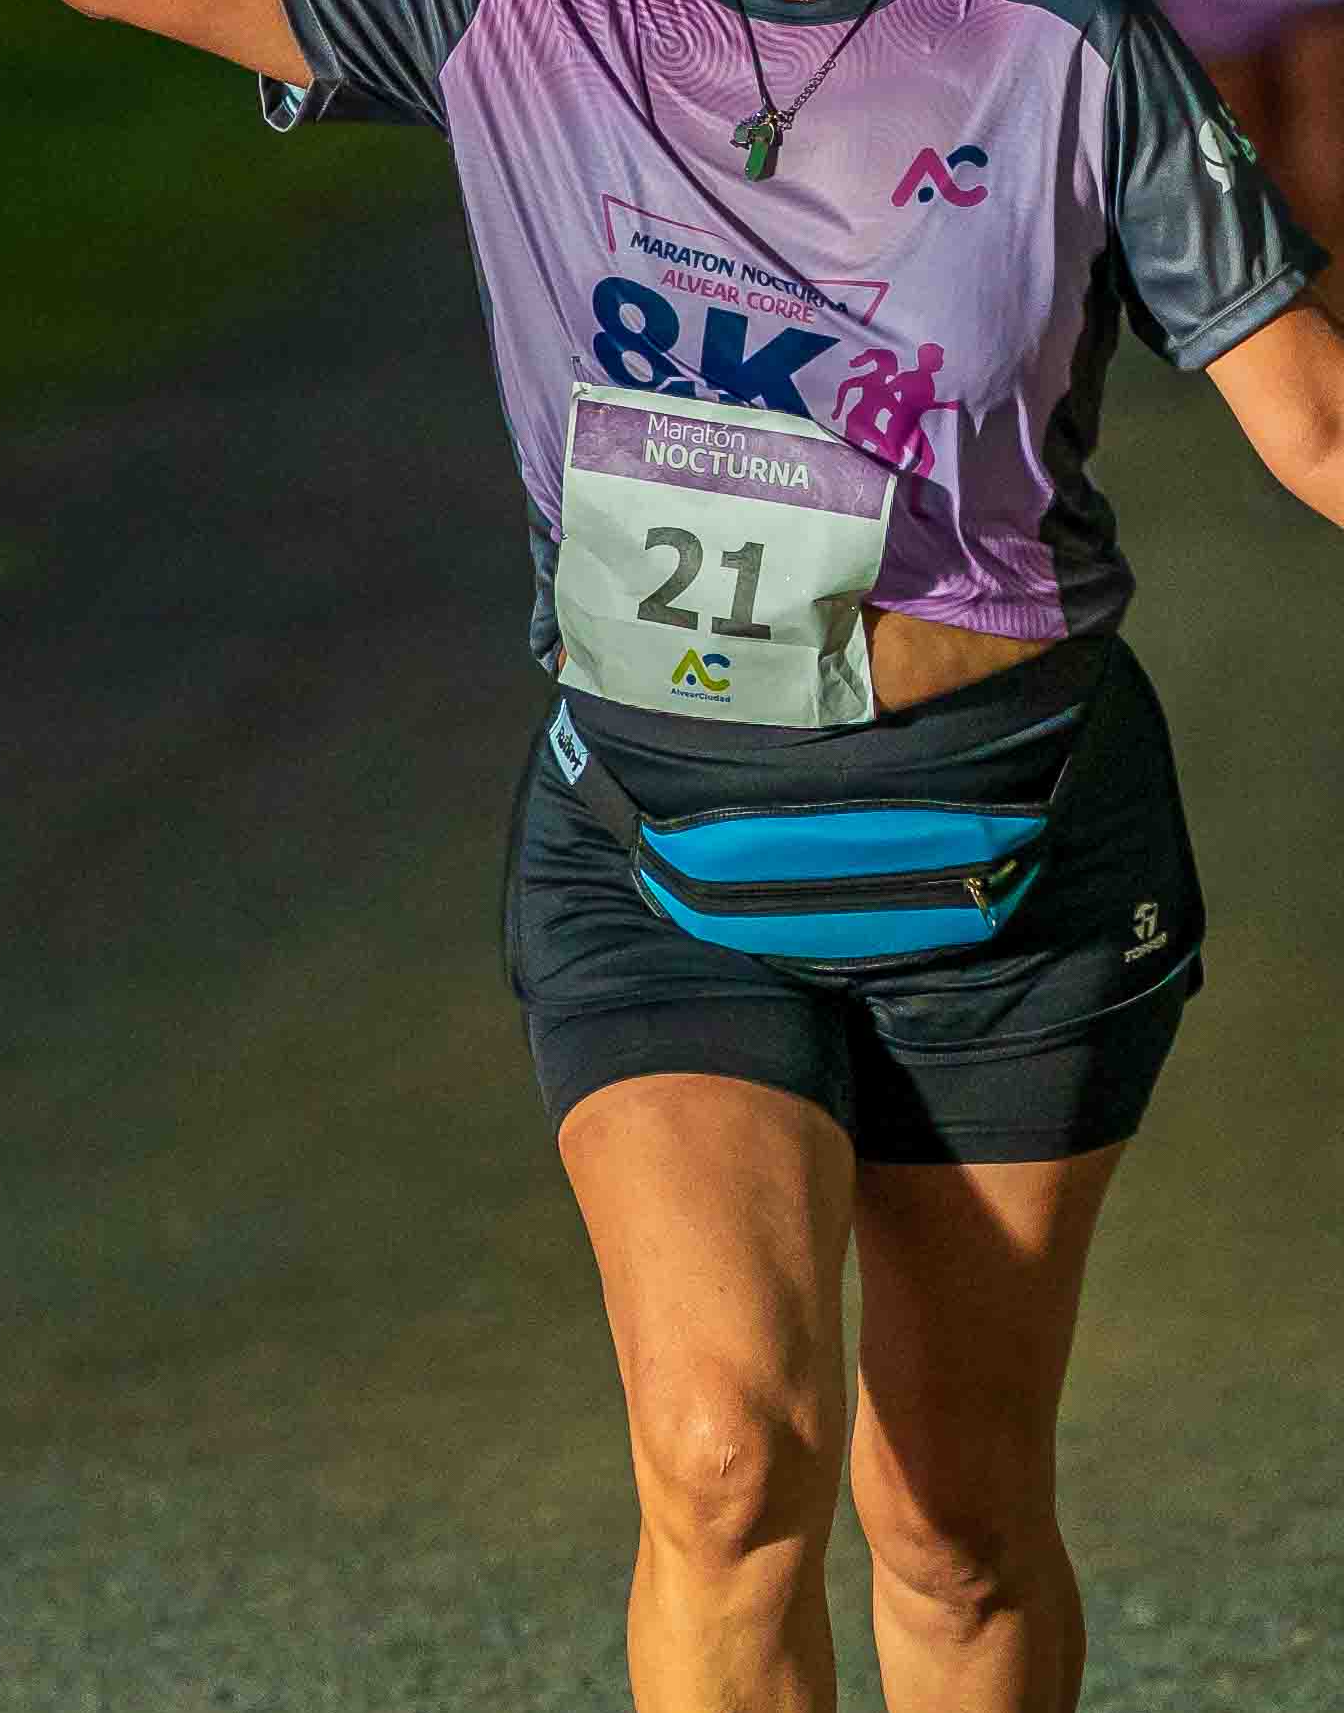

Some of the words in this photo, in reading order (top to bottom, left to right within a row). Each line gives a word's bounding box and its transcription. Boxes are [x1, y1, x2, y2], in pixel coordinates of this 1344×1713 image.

[630, 231, 736, 278] MARATON
[741, 264, 849, 315] NOCTURA
[660, 269, 740, 304] ALVEAR
[747, 292, 816, 324] CORRE
[592, 276, 841, 420] 8K
[647, 414, 746, 450] Maratón
[644, 439, 810, 490] NOCTURNA
[637, 526, 772, 641] 21
[671, 688, 731, 702] AlvearCiudad
